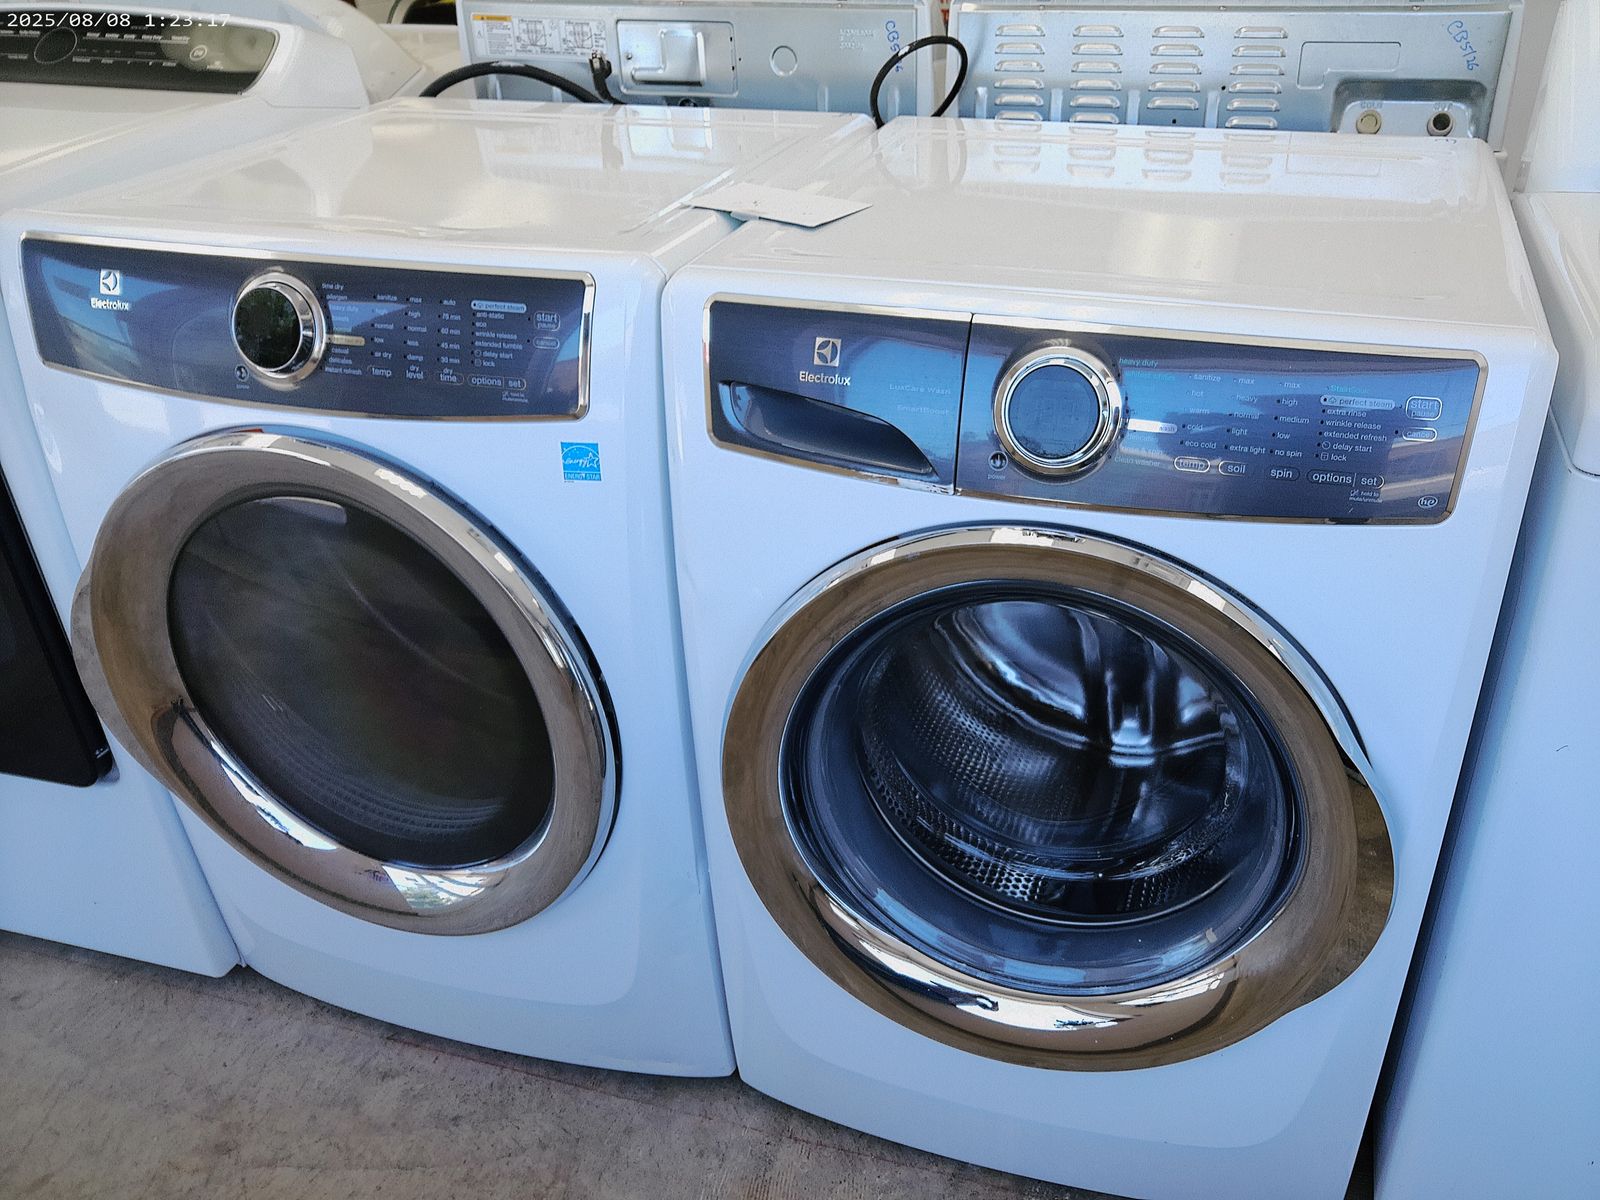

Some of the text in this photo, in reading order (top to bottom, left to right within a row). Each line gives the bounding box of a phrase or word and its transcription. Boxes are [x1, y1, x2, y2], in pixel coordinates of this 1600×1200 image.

[90, 297, 130, 311] Electrolux
[536, 313, 558, 322] start
[1142, 359, 1158, 368] duty
[372, 367, 392, 378] temp
[406, 370, 424, 380] level
[440, 373, 457, 382] time
[471, 376, 502, 386] options
[800, 370, 851, 386] Electrolux
[1194, 374, 1221, 382] sanitize
[508, 380, 521, 388] set
[889, 383, 925, 393] LuxCare
[1282, 398, 1298, 406] high
[1339, 398, 1367, 408] perfect
[1410, 398, 1438, 410] start
[1233, 411, 1260, 420] normal
[1326, 408, 1366, 418] extra rinse
[1280, 416, 1310, 424] medium
[1326, 418, 1382, 430] wrinkle release
[1232, 428, 1248, 436] light
[1276, 432, 1290, 440] low
[1324, 430, 1387, 442] extended refresh
[1230, 444, 1266, 454] extra light
[1332, 443, 1372, 452] delay start
[1286, 450, 1302, 458] spin
[1330, 453, 1347, 462] lock
[1179, 458, 1206, 470] temp
[1227, 464, 1246, 474] soil
[1270, 468, 1293, 479] spin
[1312, 472, 1352, 484] options
[1360, 476, 1377, 486] set
